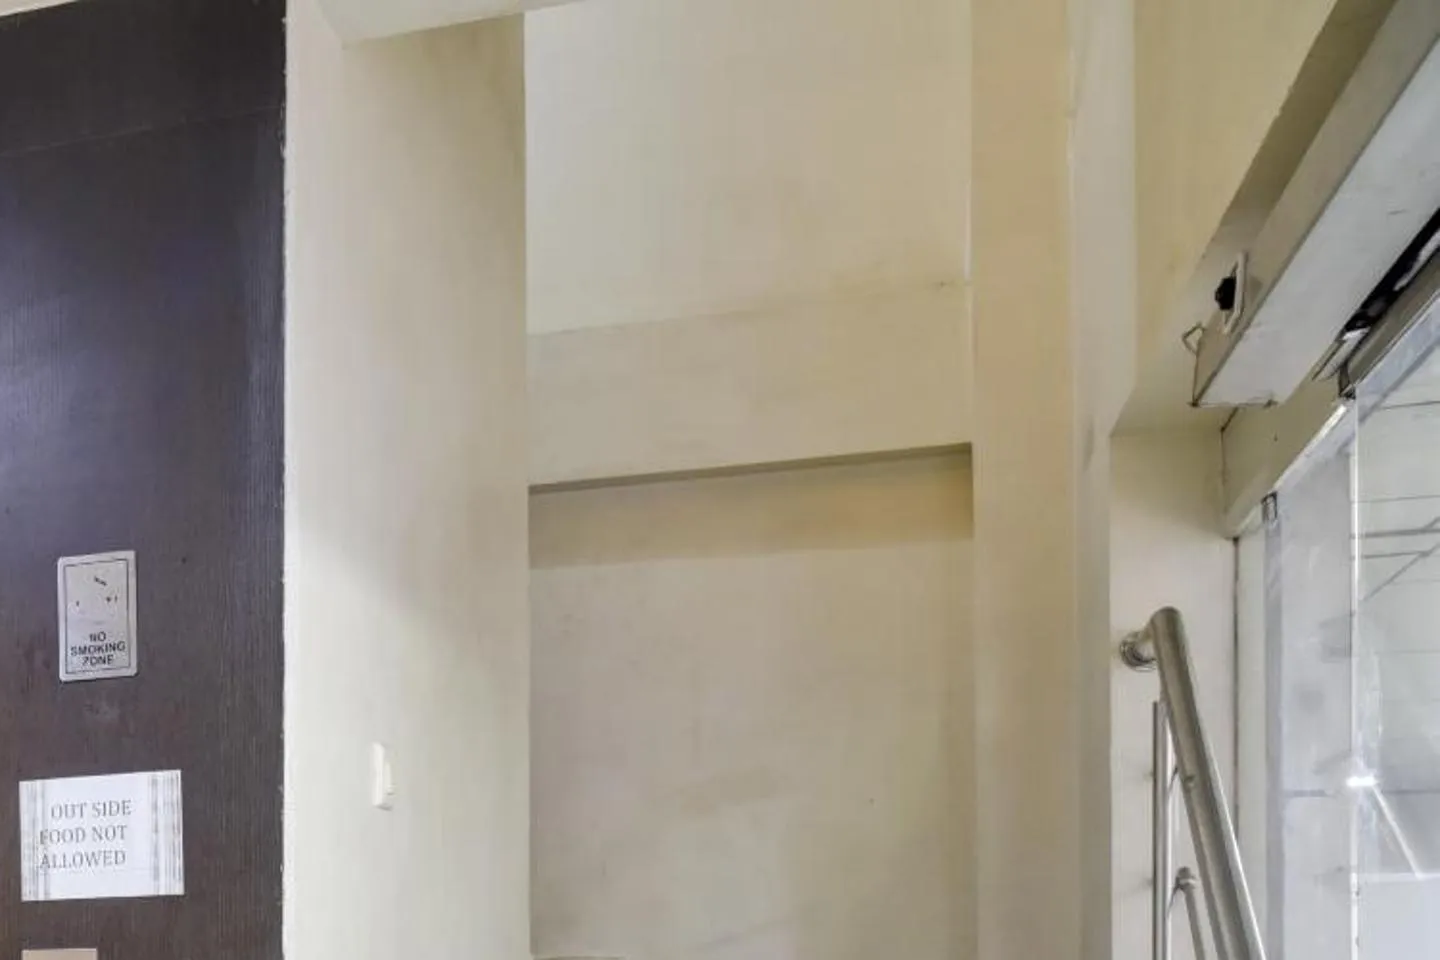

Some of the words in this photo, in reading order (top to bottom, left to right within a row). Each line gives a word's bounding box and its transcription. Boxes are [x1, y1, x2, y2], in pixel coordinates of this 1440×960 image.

[89, 631, 106, 642] NO
[71, 641, 126, 656] SMOKING
[82, 655, 113, 666] ZONE
[51, 803, 87, 820] OUT
[91, 799, 132, 817] SIDE
[39, 828, 86, 845] FOOD
[91, 825, 127, 842] NOT
[37, 850, 126, 869] ALLOWED
